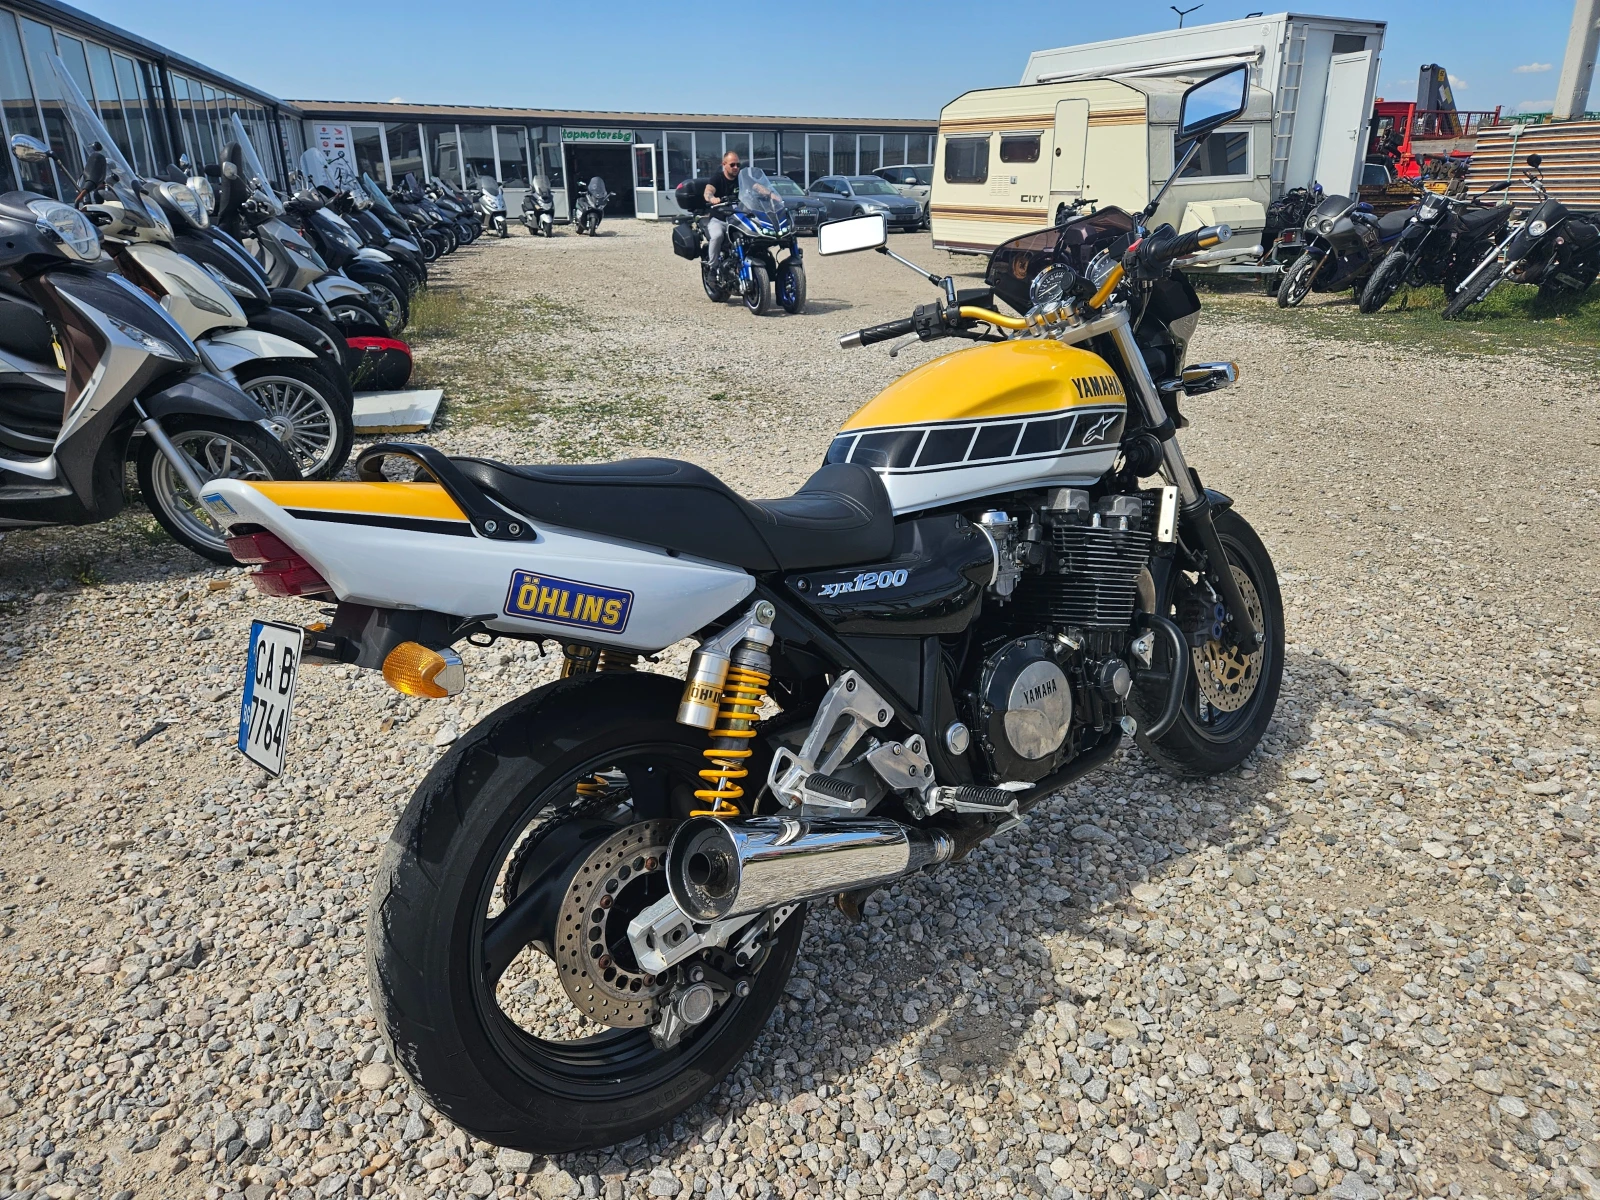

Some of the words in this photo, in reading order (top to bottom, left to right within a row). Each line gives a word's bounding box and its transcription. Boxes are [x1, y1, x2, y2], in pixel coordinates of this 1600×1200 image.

[562, 128, 632, 142] topmotorsbg
[1020, 194, 1044, 203] CITY
[1071, 375, 1122, 399] YAMAHA
[817, 568, 909, 599] XJR1200
[516, 575, 623, 627] ÖHLINS
[1023, 678, 1057, 705] YAMAHA
[248, 695, 285, 757] 7764
